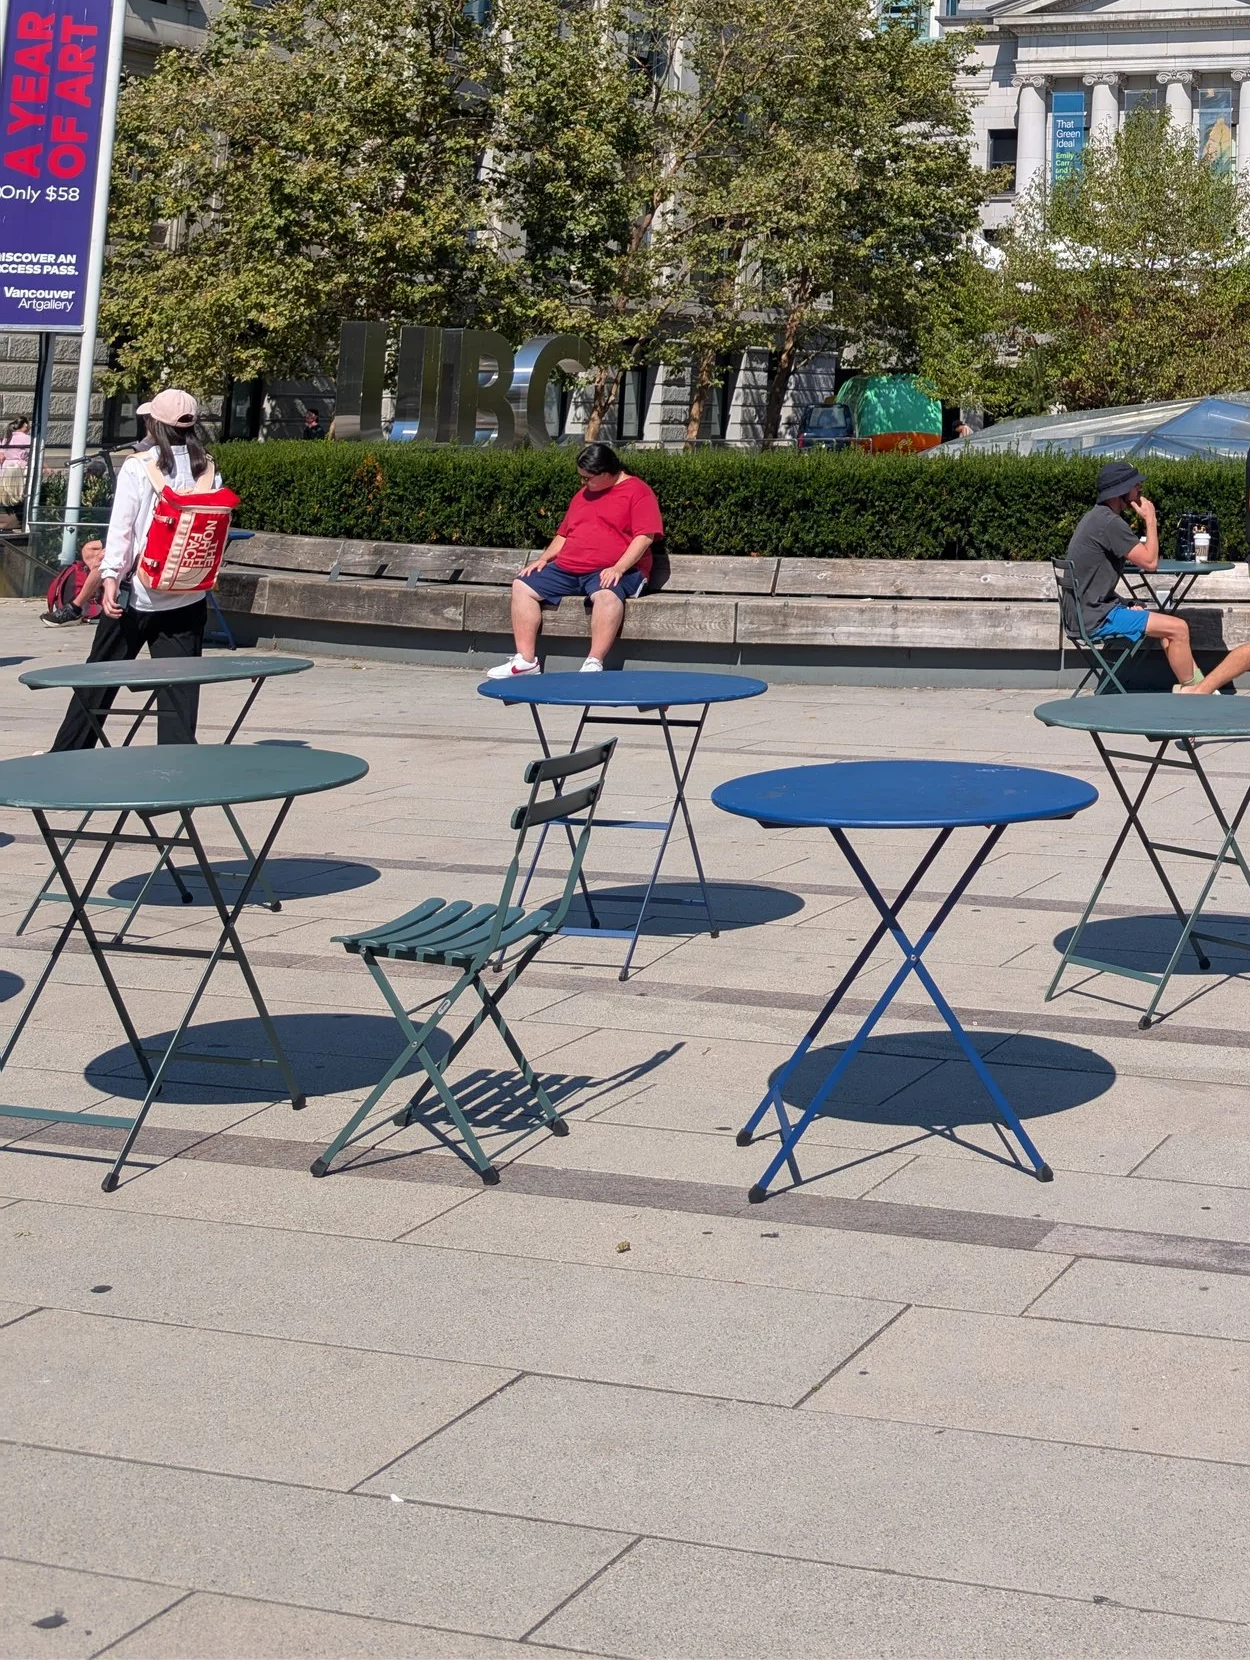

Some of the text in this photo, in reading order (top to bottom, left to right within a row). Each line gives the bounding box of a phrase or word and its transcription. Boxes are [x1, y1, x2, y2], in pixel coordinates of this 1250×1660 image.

[3, 11, 56, 178] A YEAR
[47, 15, 98, 179] OF ART
[1056, 120, 1074, 129] That
[1056, 130, 1080, 138] Green
[1056, 140, 1075, 148] Ideal
[1056, 152, 1074, 160] Emily
[1, 185, 80, 203] Only $58
[0, 252, 77, 264] ISCOVER AN
[0, 264, 79, 275] CCESS PASS.
[4, 286, 75, 299] Vancouver
[18, 298, 74, 312] Artgallery
[335, 321, 592, 447] UBC
[181, 533, 203, 567] FACE
[192, 520, 218, 567] NORTH
[204, 540, 219, 567] THE
